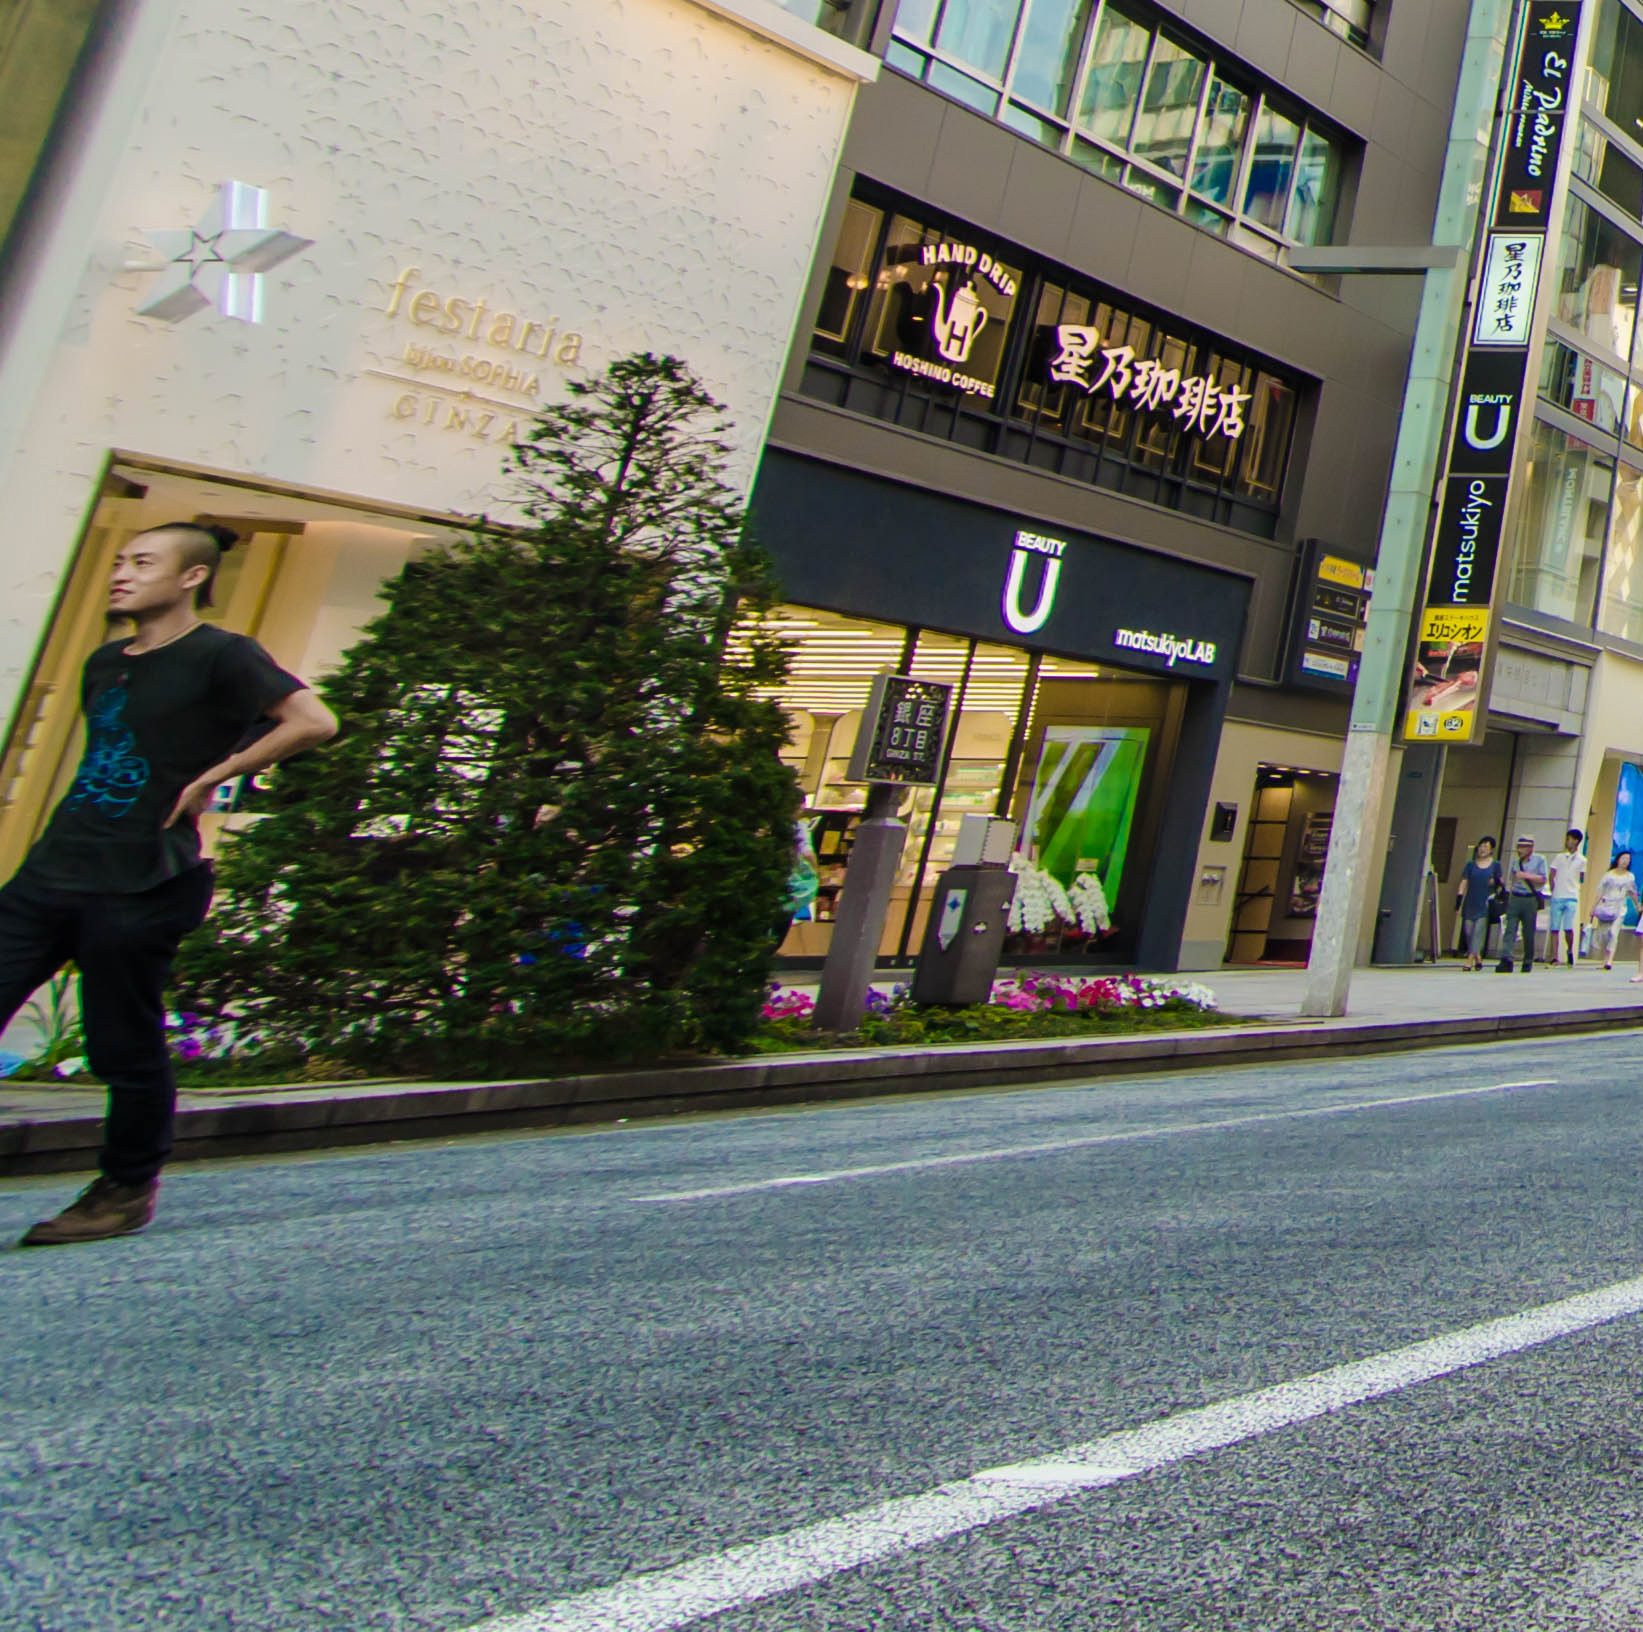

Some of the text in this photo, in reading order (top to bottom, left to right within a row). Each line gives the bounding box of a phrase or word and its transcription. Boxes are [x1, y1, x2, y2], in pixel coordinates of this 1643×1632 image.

[922, 244, 976, 266] HAND
[1492, 242, 1527, 335] 星乃珈琲店
[387, 267, 583, 366] festaria
[460, 355, 540, 396] SOPHIA
[893, 352, 995, 398] HOSHINO COFFEE
[1050, 325, 1252, 440] 星乃珈琲店
[394, 394, 518, 443] GINZA
[1469, 394, 1512, 403] BEAUTY
[1465, 404, 1511, 450] U
[1014, 531, 1067, 556] BEAUTY
[1452, 480, 1493, 603] matsukiyo
[1001, 549, 1062, 634] U
[1114, 628, 1216, 667] matsukiyoLAB
